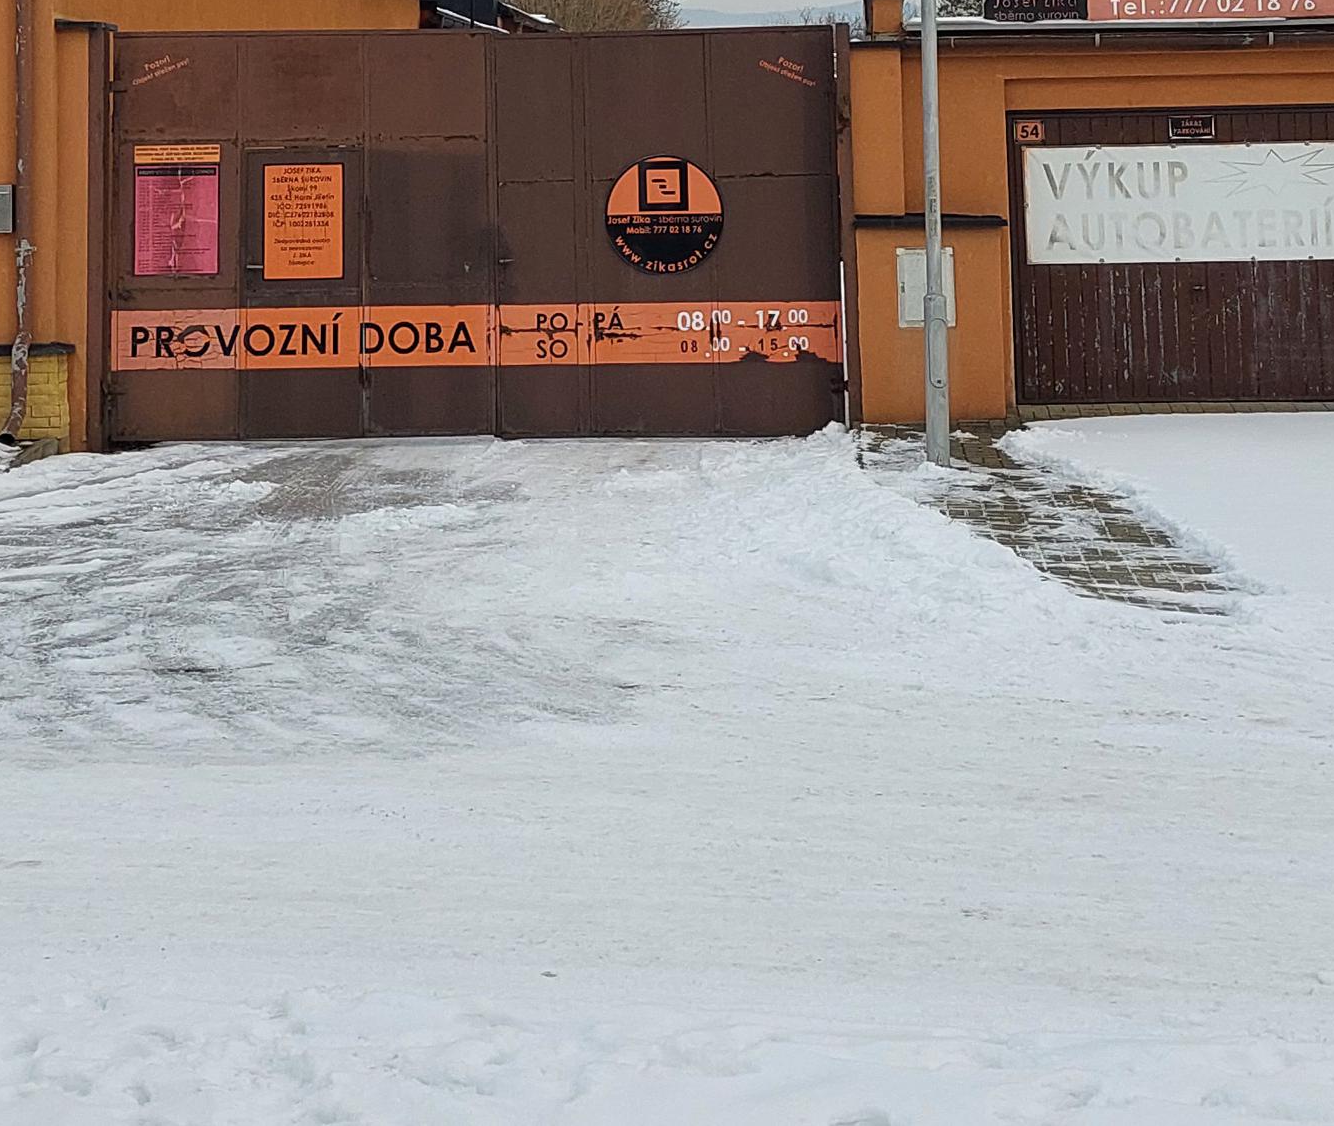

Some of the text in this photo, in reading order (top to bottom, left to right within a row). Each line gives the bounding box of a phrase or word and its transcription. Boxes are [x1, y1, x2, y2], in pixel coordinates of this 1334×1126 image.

[1038, 11, 1079, 20] surovin
[1020, 124, 1039, 138] 54
[1042, 150, 1188, 201] VÝKUP
[607, 216, 630, 225] Josef
[632, 216, 651, 224] Zika
[690, 215, 723, 224] surovin
[653, 226, 667, 234] 777
[669, 226, 680, 234] 02
[681, 226, 691, 234] 18
[692, 226, 703, 234] 76
[1046, 196, 1334, 252] AUTOBATERIÍ
[615, 233, 718, 272] www.zikasrot.cz
[593, 306, 624, 331] PÁ
[131, 312, 476, 358] PROVOZNÍ DOBA
[536, 339, 568, 359] SO
